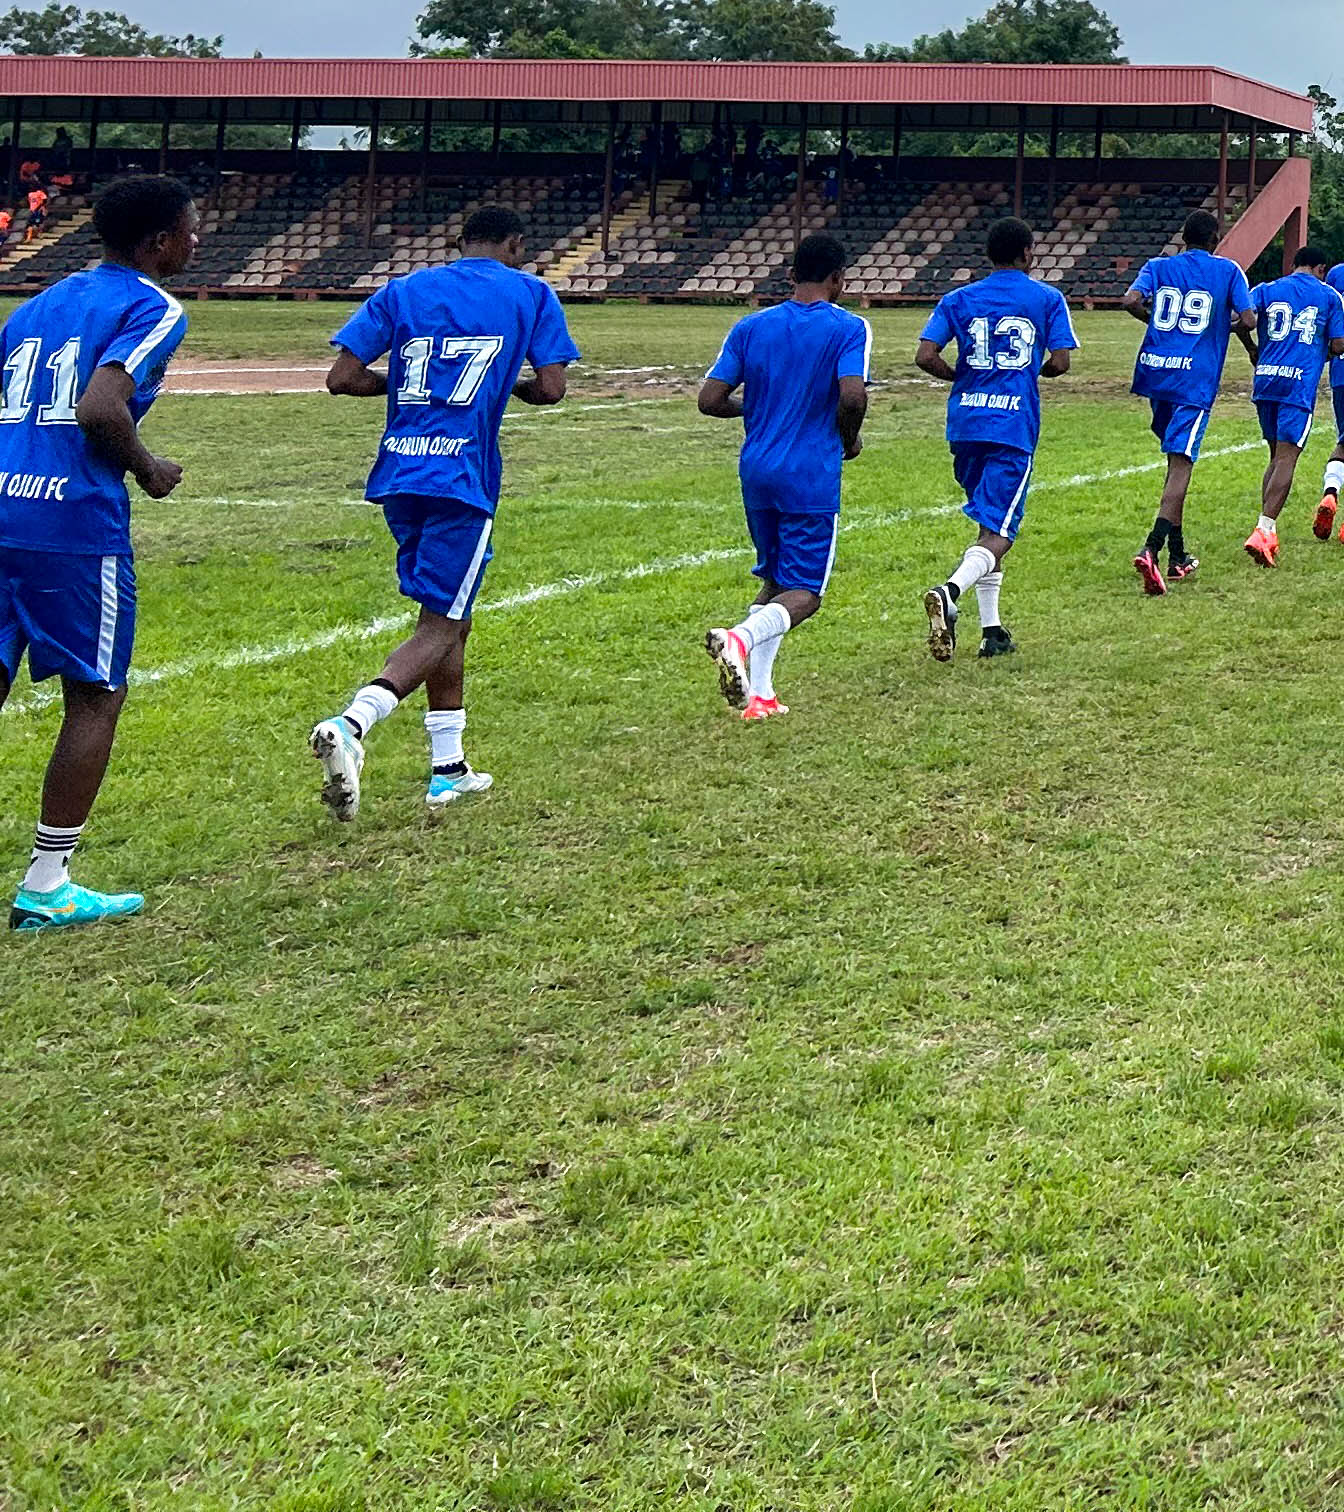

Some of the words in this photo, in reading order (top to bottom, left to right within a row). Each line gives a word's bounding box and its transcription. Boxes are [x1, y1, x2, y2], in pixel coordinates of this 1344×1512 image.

[1153, 286, 1213, 334] 09
[1266, 301, 1318, 345] 04
[966, 316, 1036, 370] 13
[0, 337, 81, 426] 11
[397, 335, 504, 406] 17
[7, 473, 46, 499] OJIJI
[44, 477, 69, 501] FC
